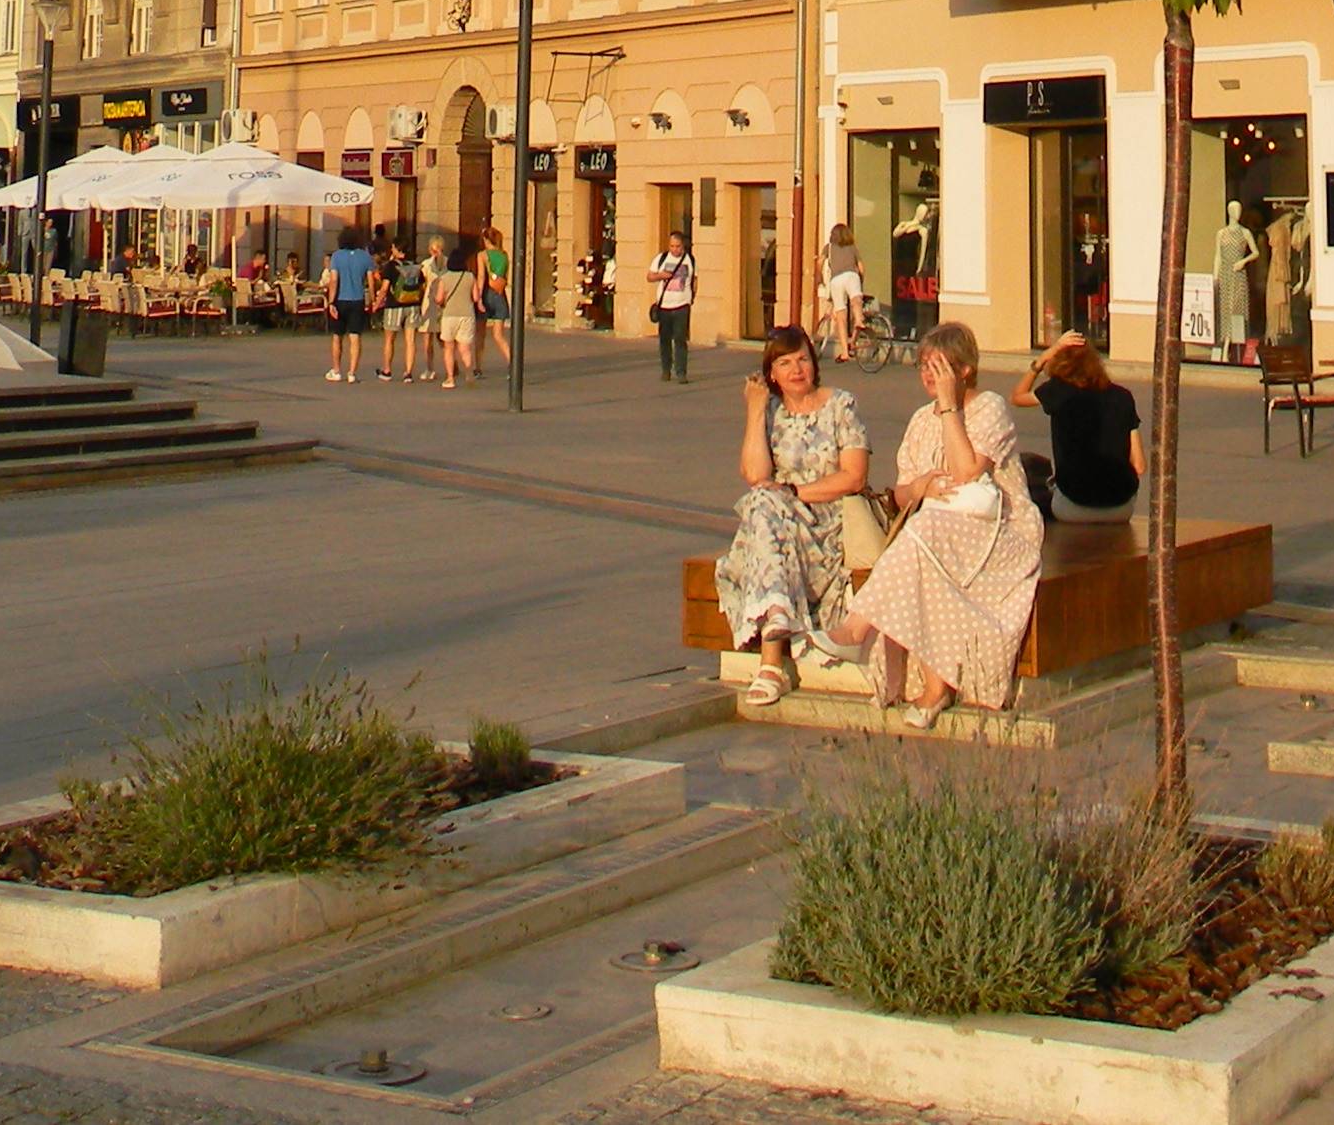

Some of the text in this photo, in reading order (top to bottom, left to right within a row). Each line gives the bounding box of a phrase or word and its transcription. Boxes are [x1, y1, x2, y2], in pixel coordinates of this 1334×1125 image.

[533, 153, 550, 171] LEO
[324, 190, 360, 204] rosa
[897, 276, 938, 300] SALE
[1185, 312, 1211, 337] -20%
